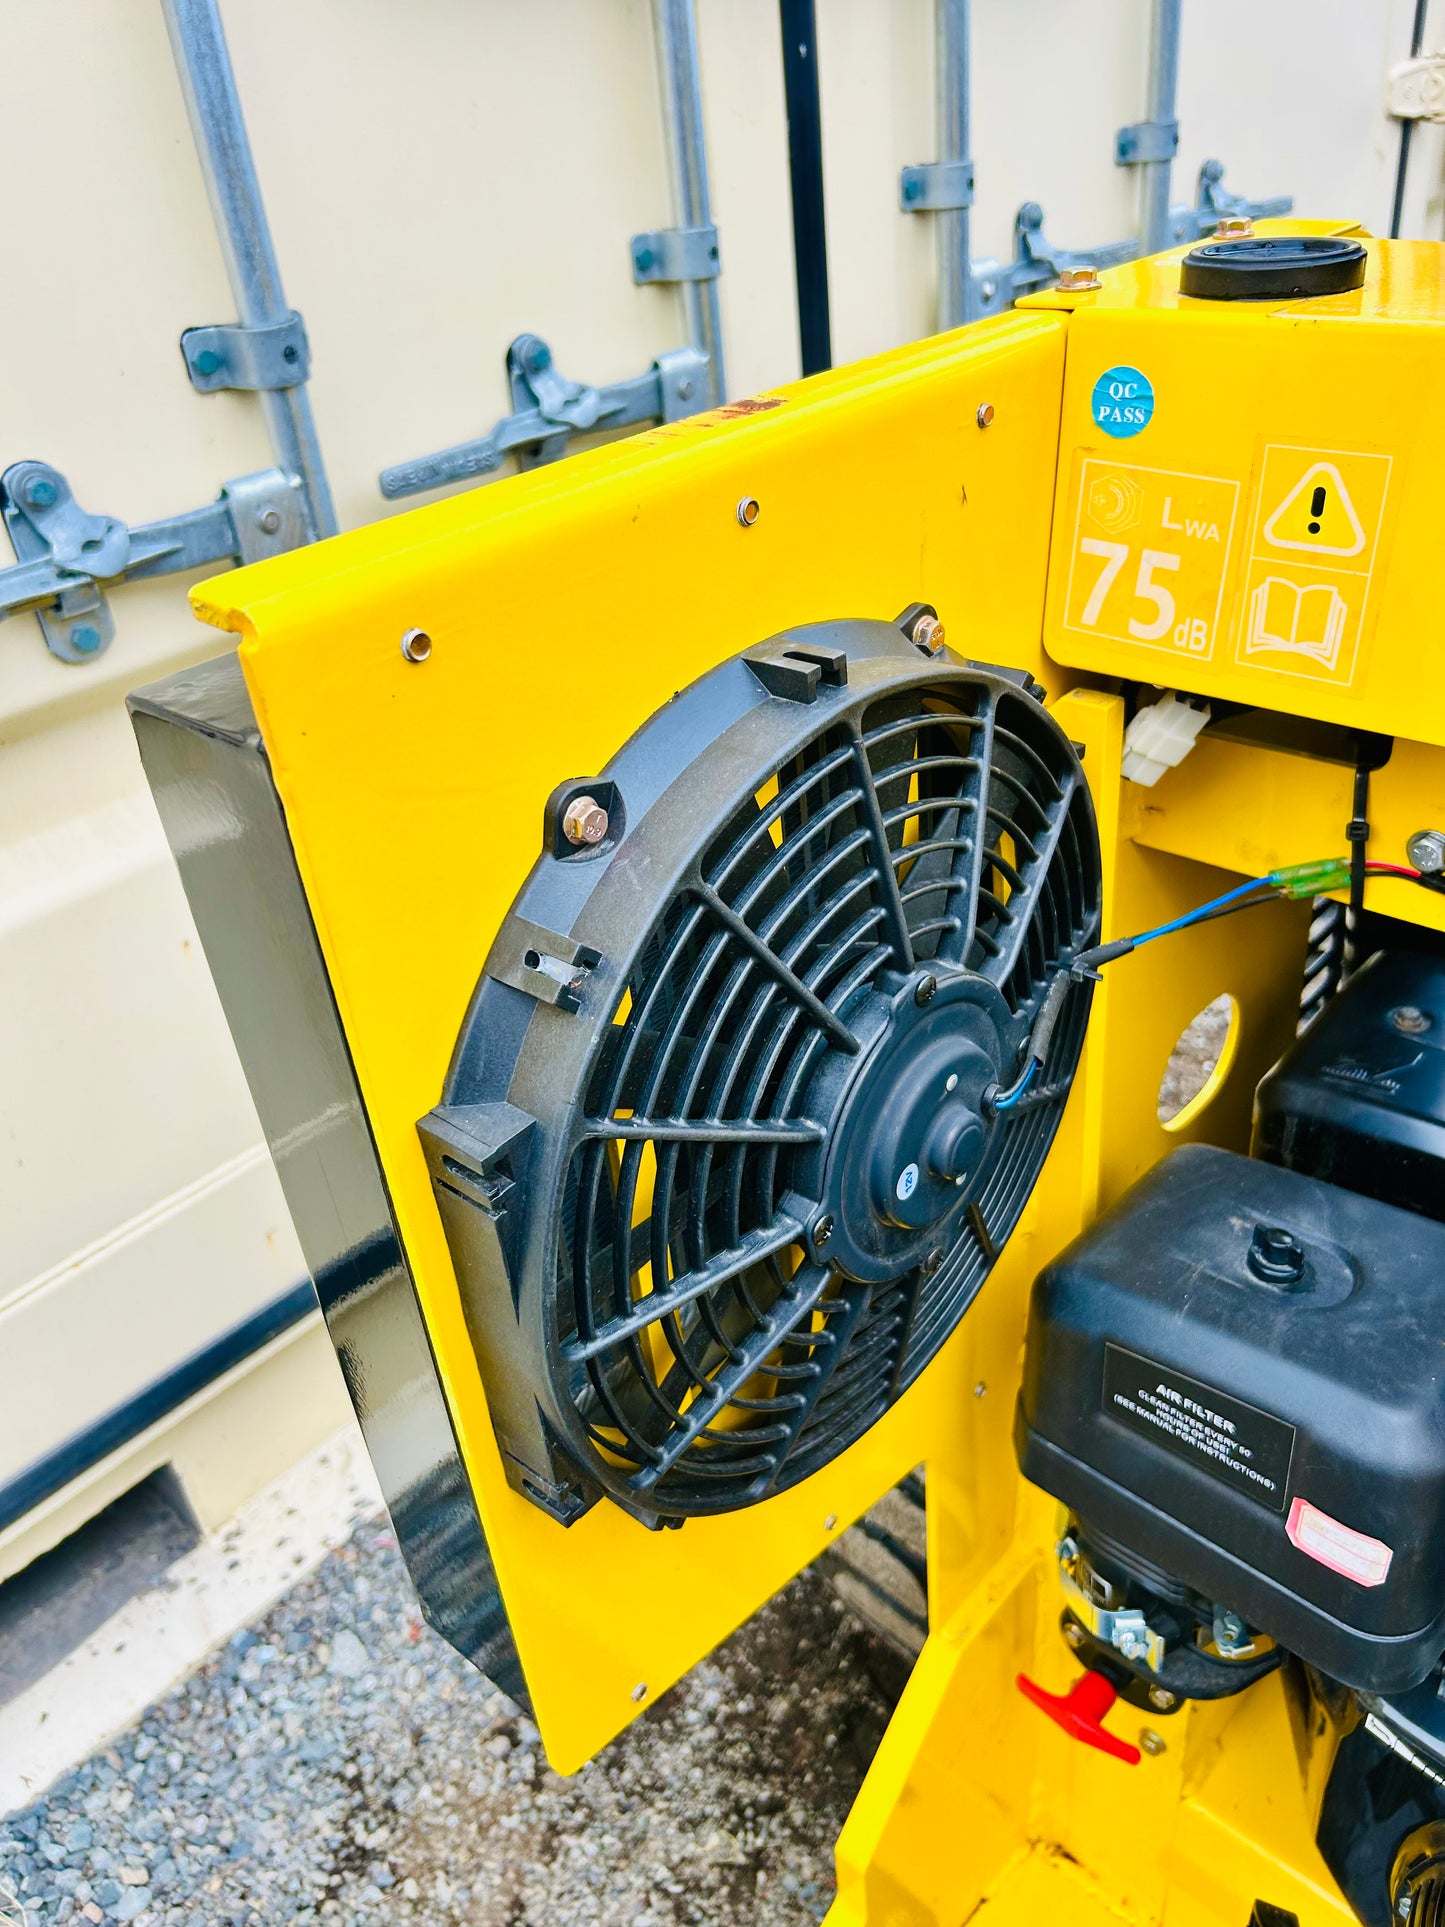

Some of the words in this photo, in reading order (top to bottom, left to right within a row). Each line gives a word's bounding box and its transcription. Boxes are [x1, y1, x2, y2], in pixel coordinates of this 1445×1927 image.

[1097, 406, 1145, 424] PASS
[1109, 382, 1138, 401] QC
[1080, 537, 1181, 640] 75
[1174, 617, 1207, 651] dB
[1138, 1390, 1170, 1412] CLEAN
[1170, 1407, 1204, 1432] FILTER
[1204, 1426, 1239, 1451] EVERY
[1156, 1384, 1183, 1406] AIR
[1184, 1398, 1237, 1435] FILTER
[1156, 1408, 1190, 1433] HOURS
[1191, 1428, 1205, 1440] OF
[1136, 1406, 1175, 1435] MANUAL
[1175, 1428, 1197, 1446] FOR
[1197, 1441, 1276, 1492] INSTRUCTIONS)
